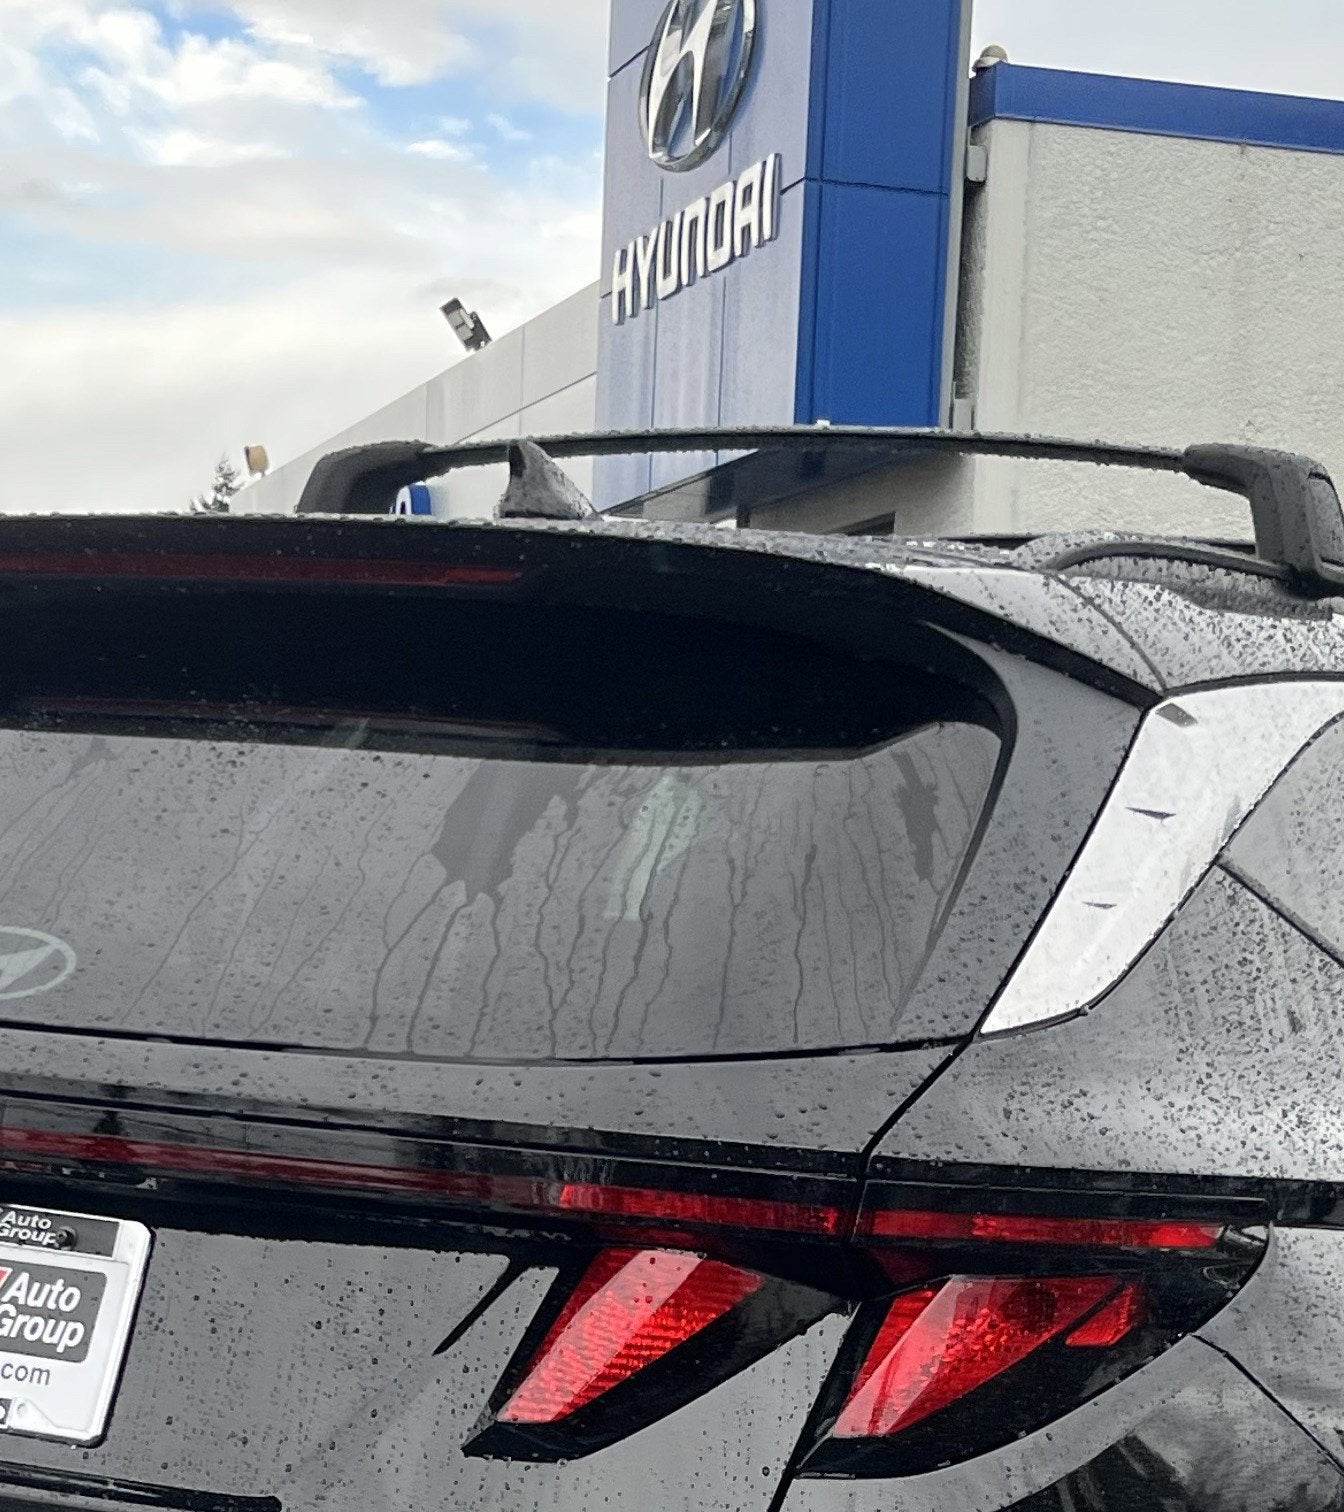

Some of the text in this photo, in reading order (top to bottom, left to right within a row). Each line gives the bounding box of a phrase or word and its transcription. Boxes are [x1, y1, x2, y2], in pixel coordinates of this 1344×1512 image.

[612, 152, 781, 325] HYUNDAI
[2, 1211, 51, 1230] Auto
[1, 1272, 81, 1312] Auto
